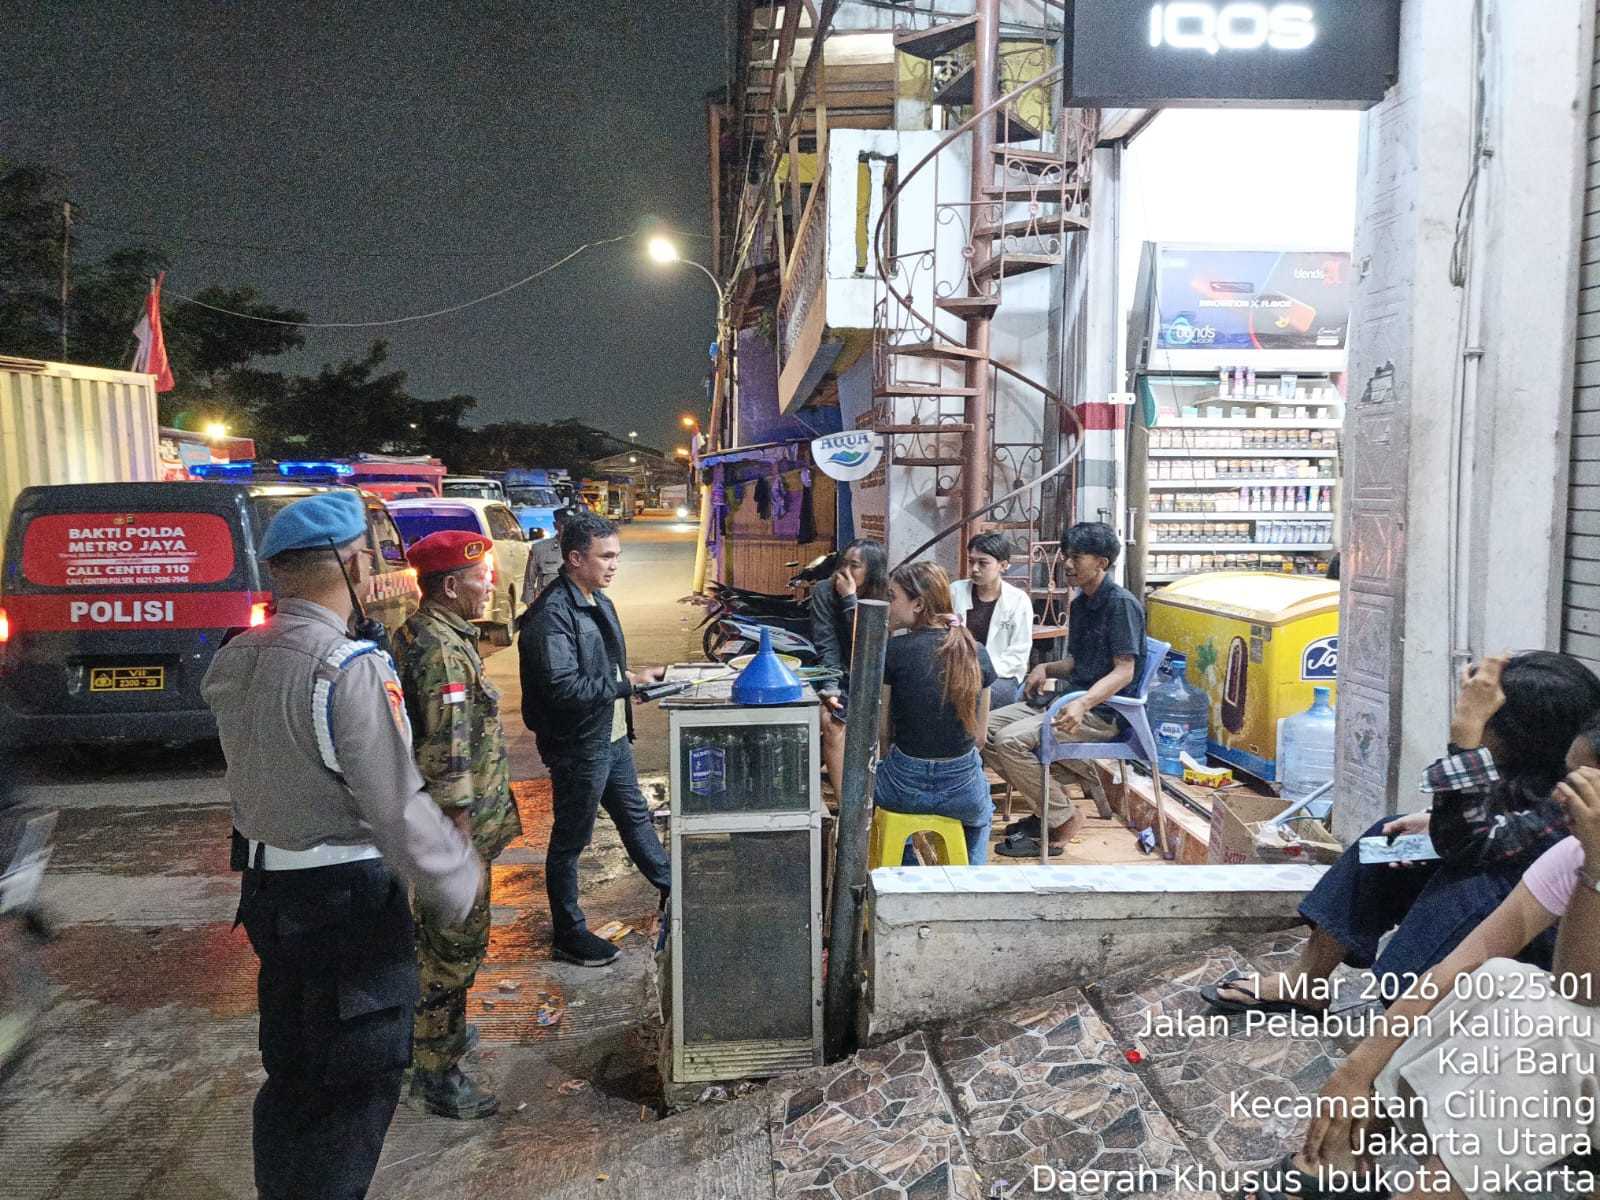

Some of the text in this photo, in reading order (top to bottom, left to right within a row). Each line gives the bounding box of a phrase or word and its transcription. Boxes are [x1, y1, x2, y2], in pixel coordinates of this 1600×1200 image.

[1149, 3, 1316, 56] IQOS
[69, 527, 185, 539] BAKTI POLDA
[69, 540, 187, 552] METRO JAYA
[66, 564, 190, 576] CALL CENTER 110
[70, 601, 174, 623] POLISI
